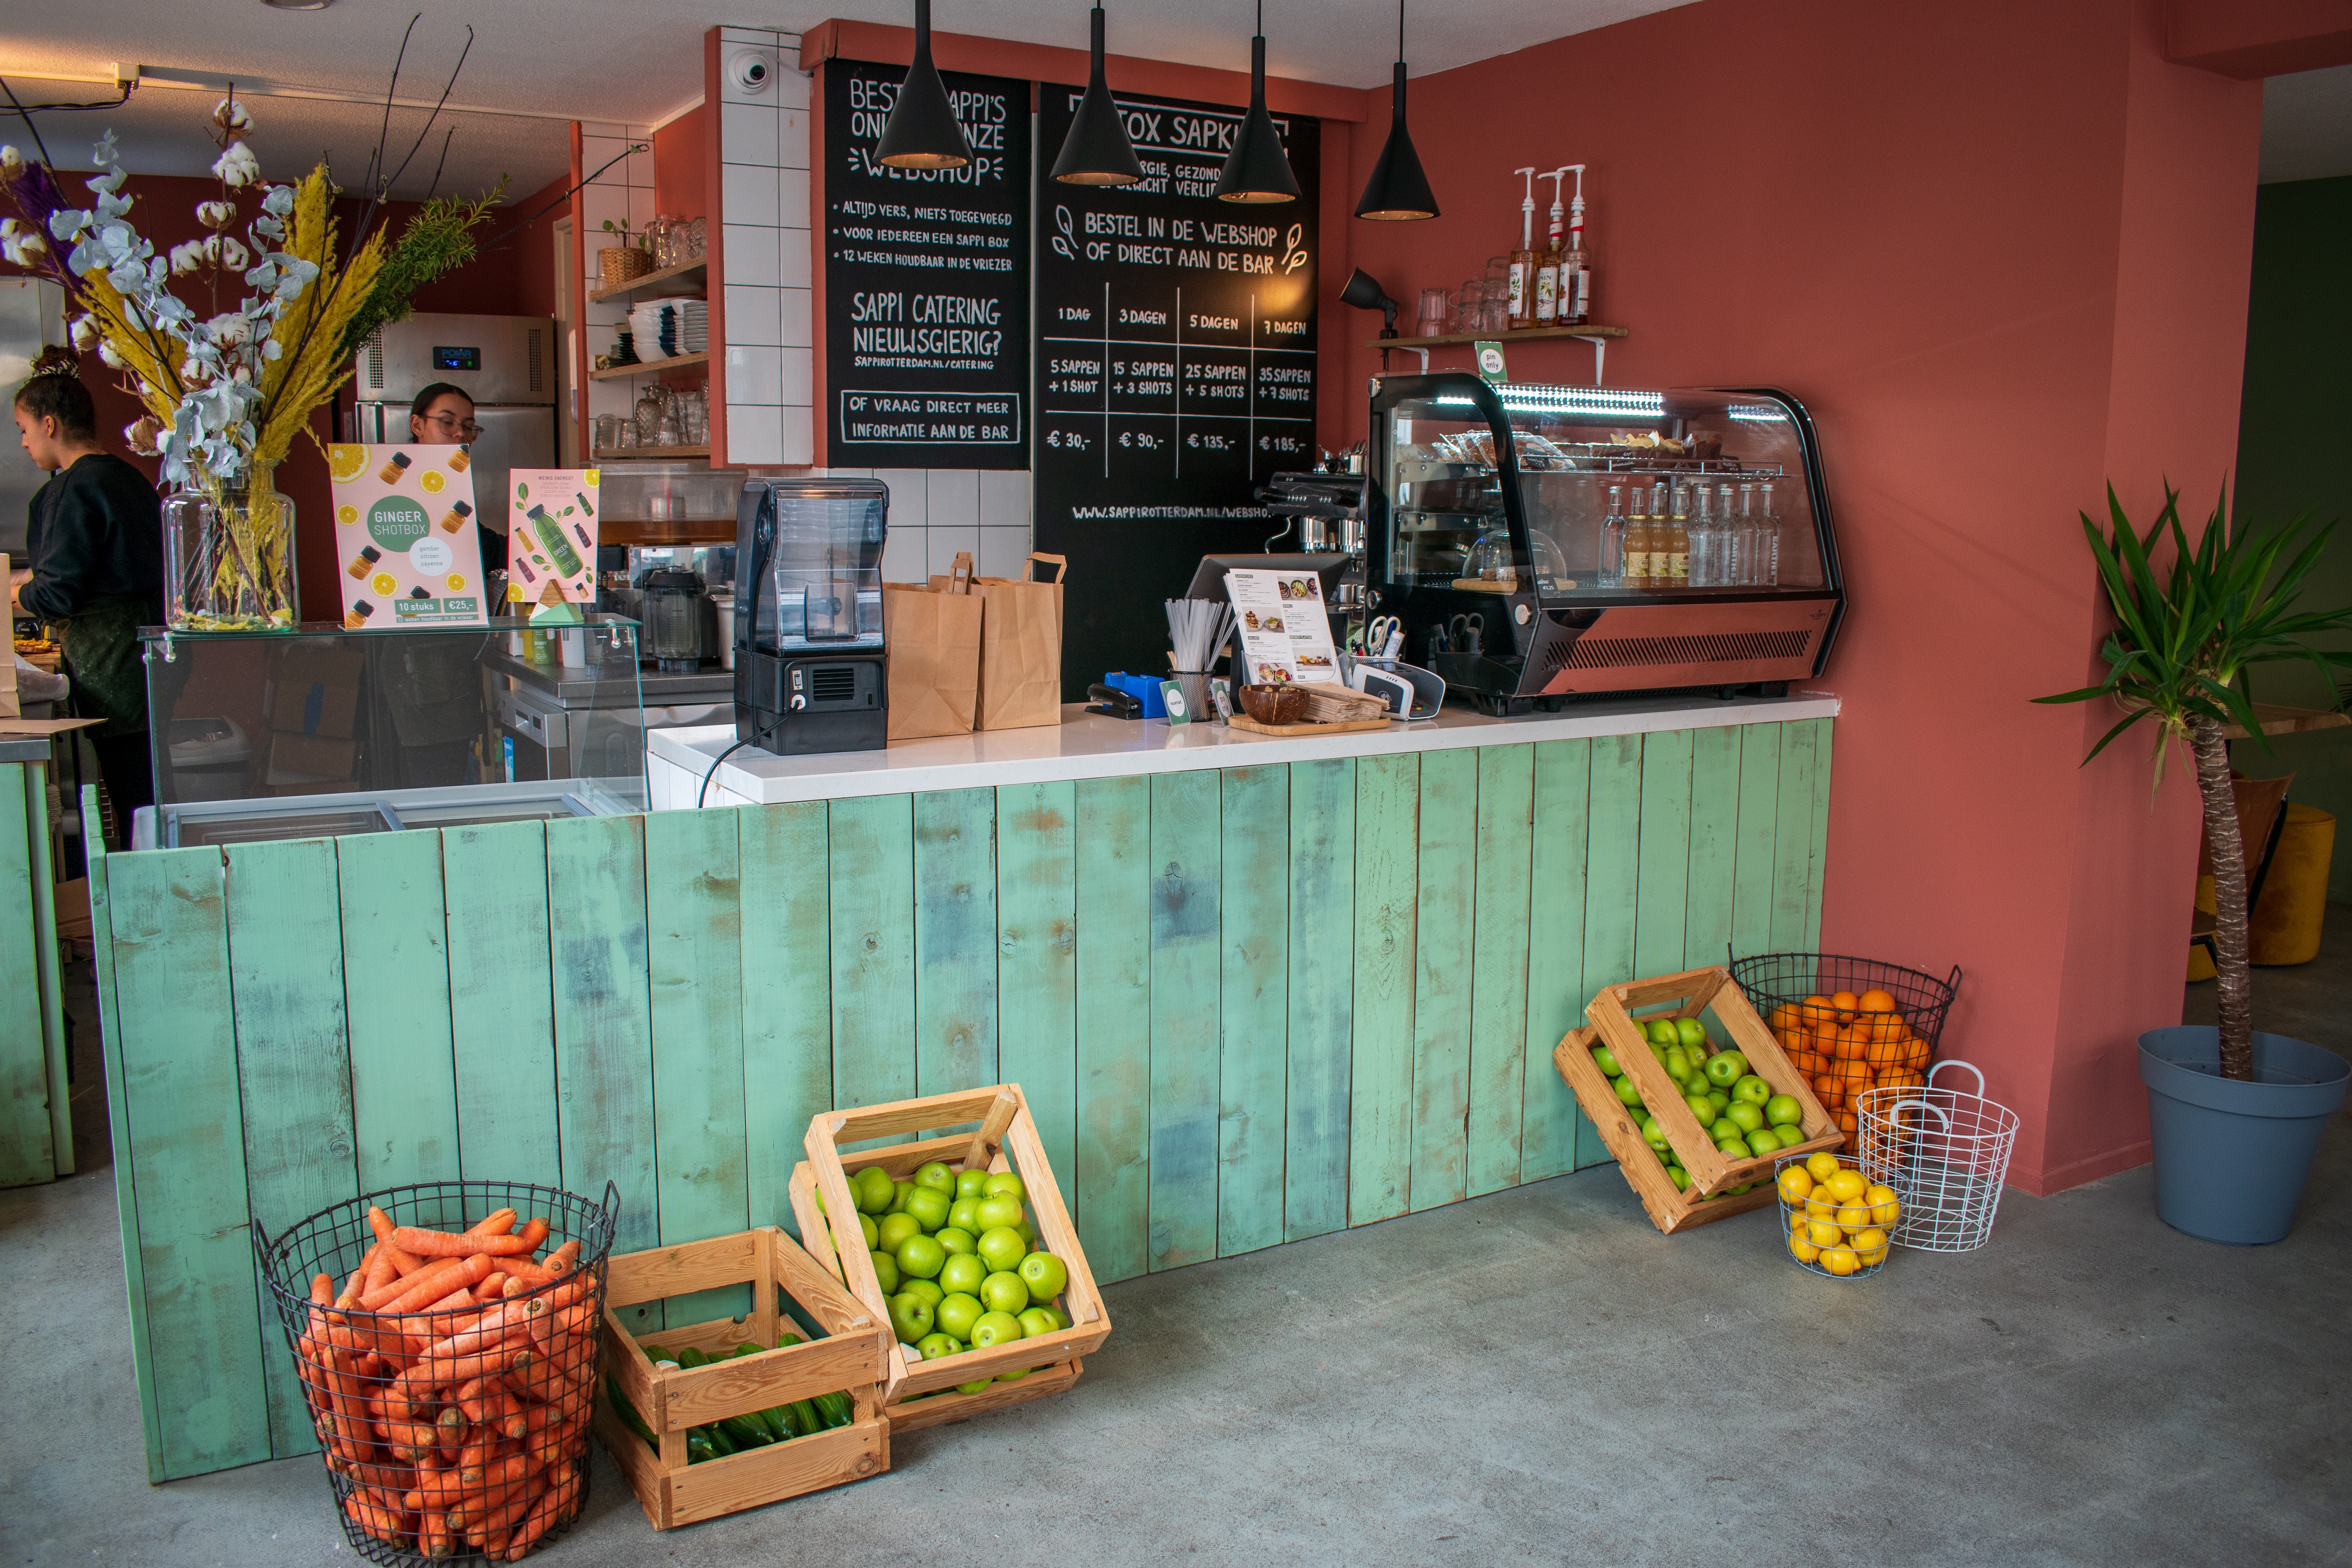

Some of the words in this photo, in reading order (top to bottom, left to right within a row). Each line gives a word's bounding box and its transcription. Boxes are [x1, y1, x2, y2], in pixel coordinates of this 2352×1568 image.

[850, 79, 903, 111] BEST
[949, 90, 1006, 123] APPI'S
[958, 122, 1005, 150] NZE
[1140, 160, 1171, 179] RGIE,
[843, 201, 875, 218] ALTIJD
[879, 205, 910, 219] VERS,
[915, 207, 946, 220] NIETS
[949, 210, 1011, 224] TOEGEVOEGD
[843, 227, 873, 239] VOOR
[877, 230, 929, 242] IEDEREEN
[932, 233, 953, 244] EEN
[956, 234, 984, 246] SAPPI
[988, 237, 1009, 247] BOX
[1085, 213, 1142, 236] BESTEL
[1149, 217, 1164, 237] IN
[1173, 220, 1193, 240] DE
[1201, 222, 1277, 247] WEBSHOP
[843, 250, 854, 261] 12
[858, 251, 892, 263] WEKEN
[895, 254, 944, 266] HOUDBAAR
[948, 257, 957, 267] IN
[960, 258, 970, 269] DE
[973, 259, 1011, 270] VRIEZER
[1087, 242, 1110, 260] OF
[1118, 244, 1173, 264] DIRECT
[1178, 249, 1210, 268] AAN
[1218, 252, 1238, 271] DE
[1244, 254, 1274, 274] BAR
[852, 292, 902, 321] SAPPI
[913, 295, 1000, 324] CATERING
[1059, 308, 1063, 318] 1
[1067, 308, 1091, 320] DAG
[1119, 309, 1128, 322] 3
[1130, 311, 1166, 324] DAGEN
[1190, 315, 1198, 327] 5
[1201, 316, 1238, 330] DAGEN
[1264, 321, 1271, 334] 7
[1274, 321, 1306, 334] DAGEN
[854, 327, 1001, 355] NIEUWSGIERIG?
[855, 356, 994, 369] SAPPIROTTERDAM.NL/CATERING
[1486, 352, 1496, 362] pin
[1051, 360, 1059, 373] 5
[1061, 360, 1099, 374] SAPPEN
[1114, 362, 1124, 374] 15
[1131, 362, 1173, 377] SAPPEN
[1186, 364, 1201, 377] 25
[1204, 365, 1246, 380] SAPPEN
[1486, 361, 1498, 370] only
[1259, 367, 1272, 381] 35
[1274, 369, 1311, 382] SAPPEN
[1049, 381, 1058, 391] +
[1063, 380, 1067, 391] 1
[1070, 380, 1098, 392] SHOT
[1113, 382, 1123, 393] +
[1127, 382, 1134, 393] 3
[1138, 381, 1172, 394] SHOTS
[1186, 384, 1194, 395] +
[1200, 385, 1207, 396] 5
[1211, 386, 1244, 397] SHOTS
[1259, 387, 1267, 397] +
[1270, 387, 1276, 398] 7
[1279, 388, 1309, 400] SHOTS
[850, 397, 867, 410] OF
[874, 399, 920, 412] VRAAG
[927, 401, 971, 413] DIRECT
[977, 403, 1008, 413] MEER
[853, 423, 925, 437] INFORMATIE
[931, 424, 955, 438] AAN
[960, 425, 975, 438] DE
[982, 425, 1008, 438] BAR
[1047, 430, 1060, 446] €
[1119, 432, 1131, 446] €
[1188, 434, 1199, 447] €
[1259, 436, 1269, 450] €
[375, 511, 422, 522] GINGER
[1073, 506, 1271, 519] WWW.SAPPIROTTERDAM.NL/WEBSHO
[375, 525, 426, 535] SHOTBOX
[399, 603, 409, 611] 10
[411, 602, 434, 610] stuks
[449, 600, 473, 610] €25,-
